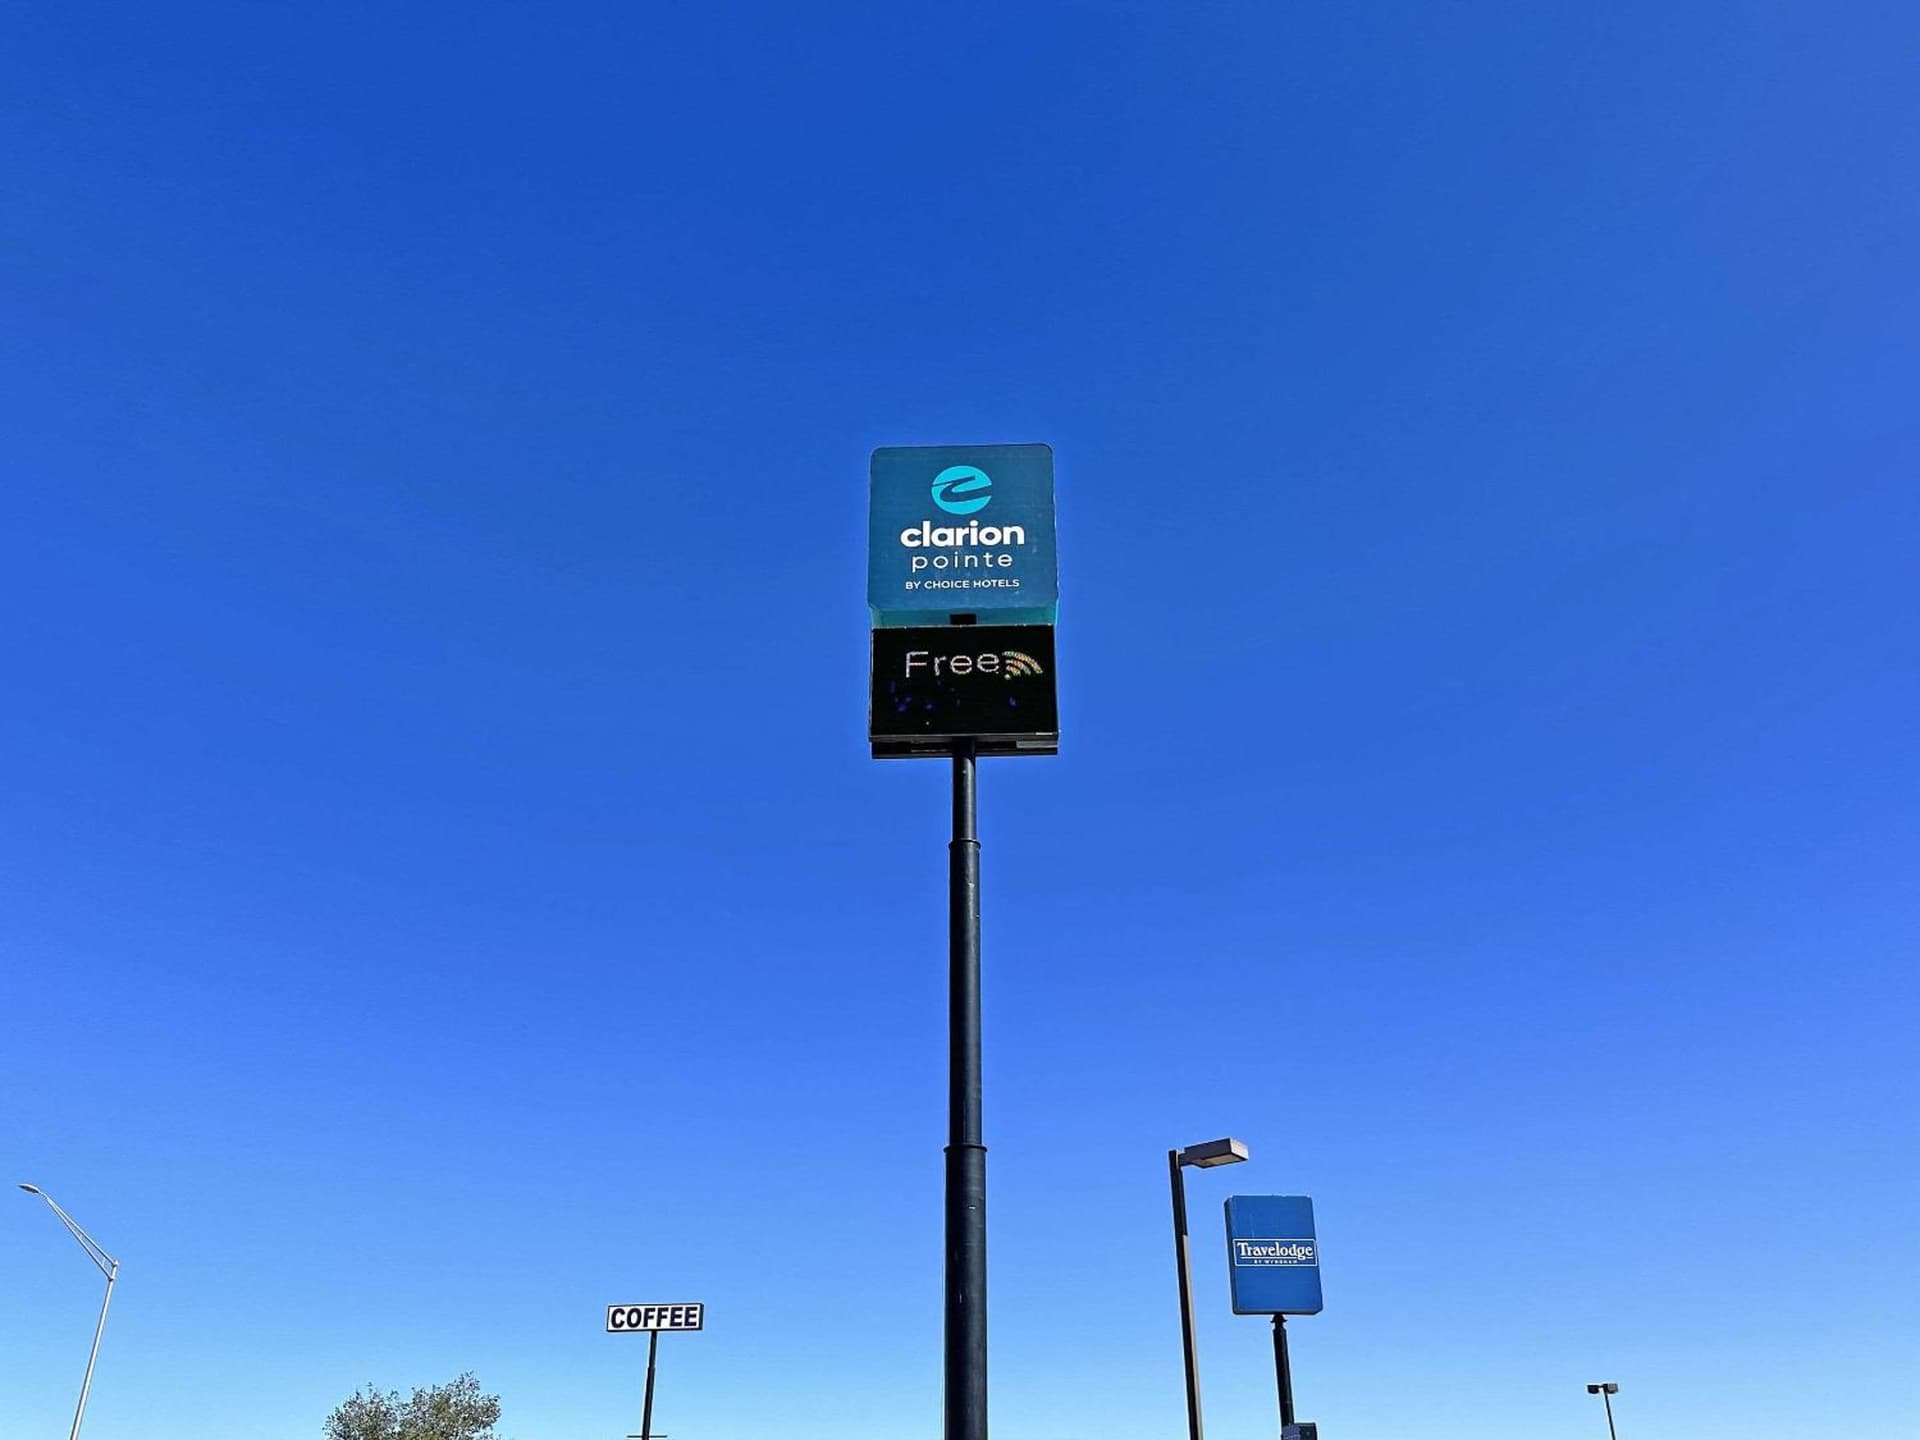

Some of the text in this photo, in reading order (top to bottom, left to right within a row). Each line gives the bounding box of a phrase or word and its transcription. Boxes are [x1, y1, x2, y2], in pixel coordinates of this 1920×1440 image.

[900, 520, 1025, 547] clarion
[912, 551, 1013, 573] pointe
[905, 578, 1020, 590] BY CHOICE HOTELS
[905, 651, 1000, 678] Free
[1236, 1241, 1314, 1260] Travelodge
[610, 1306, 698, 1329] COFFEE
